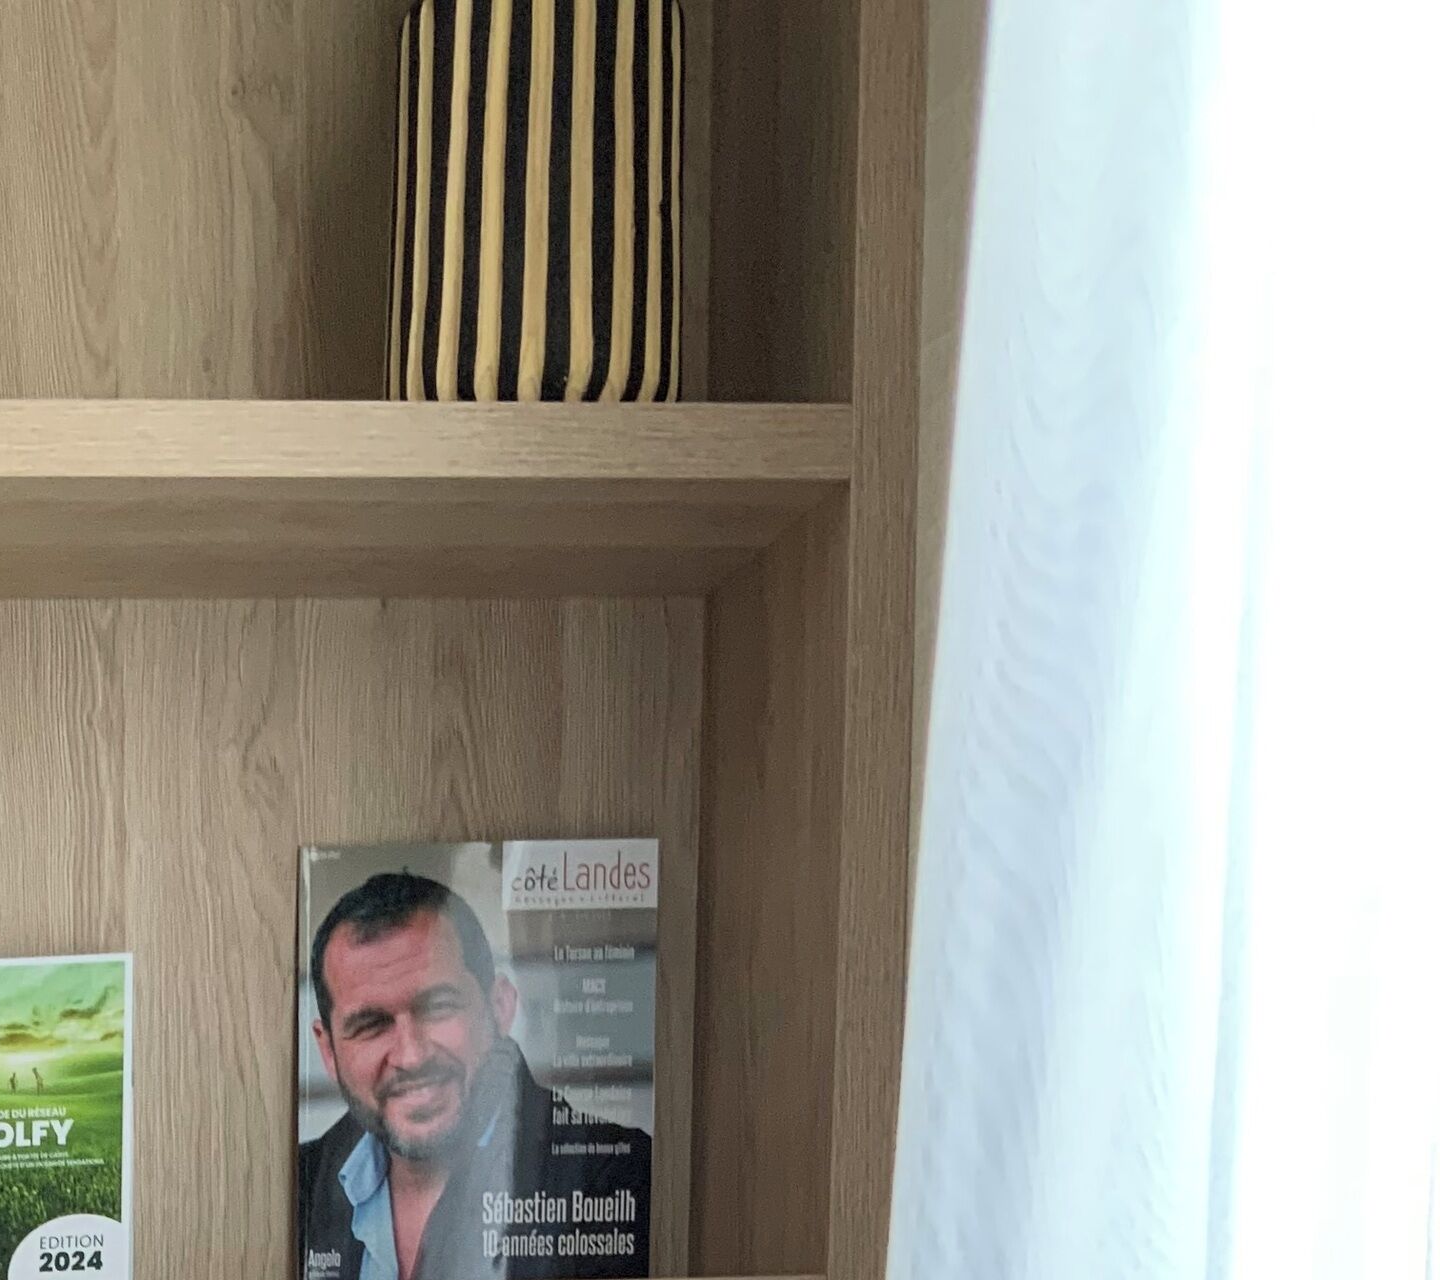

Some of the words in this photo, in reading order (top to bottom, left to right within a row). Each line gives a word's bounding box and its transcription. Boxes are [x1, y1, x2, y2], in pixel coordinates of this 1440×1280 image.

[512, 864, 558, 891] côté
[563, 850, 650, 891] Landes
[11, 1109, 27, 1119] DU
[482, 1191, 567, 1224] Sébastien
[572, 1190, 635, 1222] Boueilh
[39, 1234, 104, 1249] EDITION
[482, 1229, 498, 1257] 10
[502, 1228, 553, 1256] années
[558, 1228, 634, 1255] colossales
[39, 1250, 103, 1272] 2024
